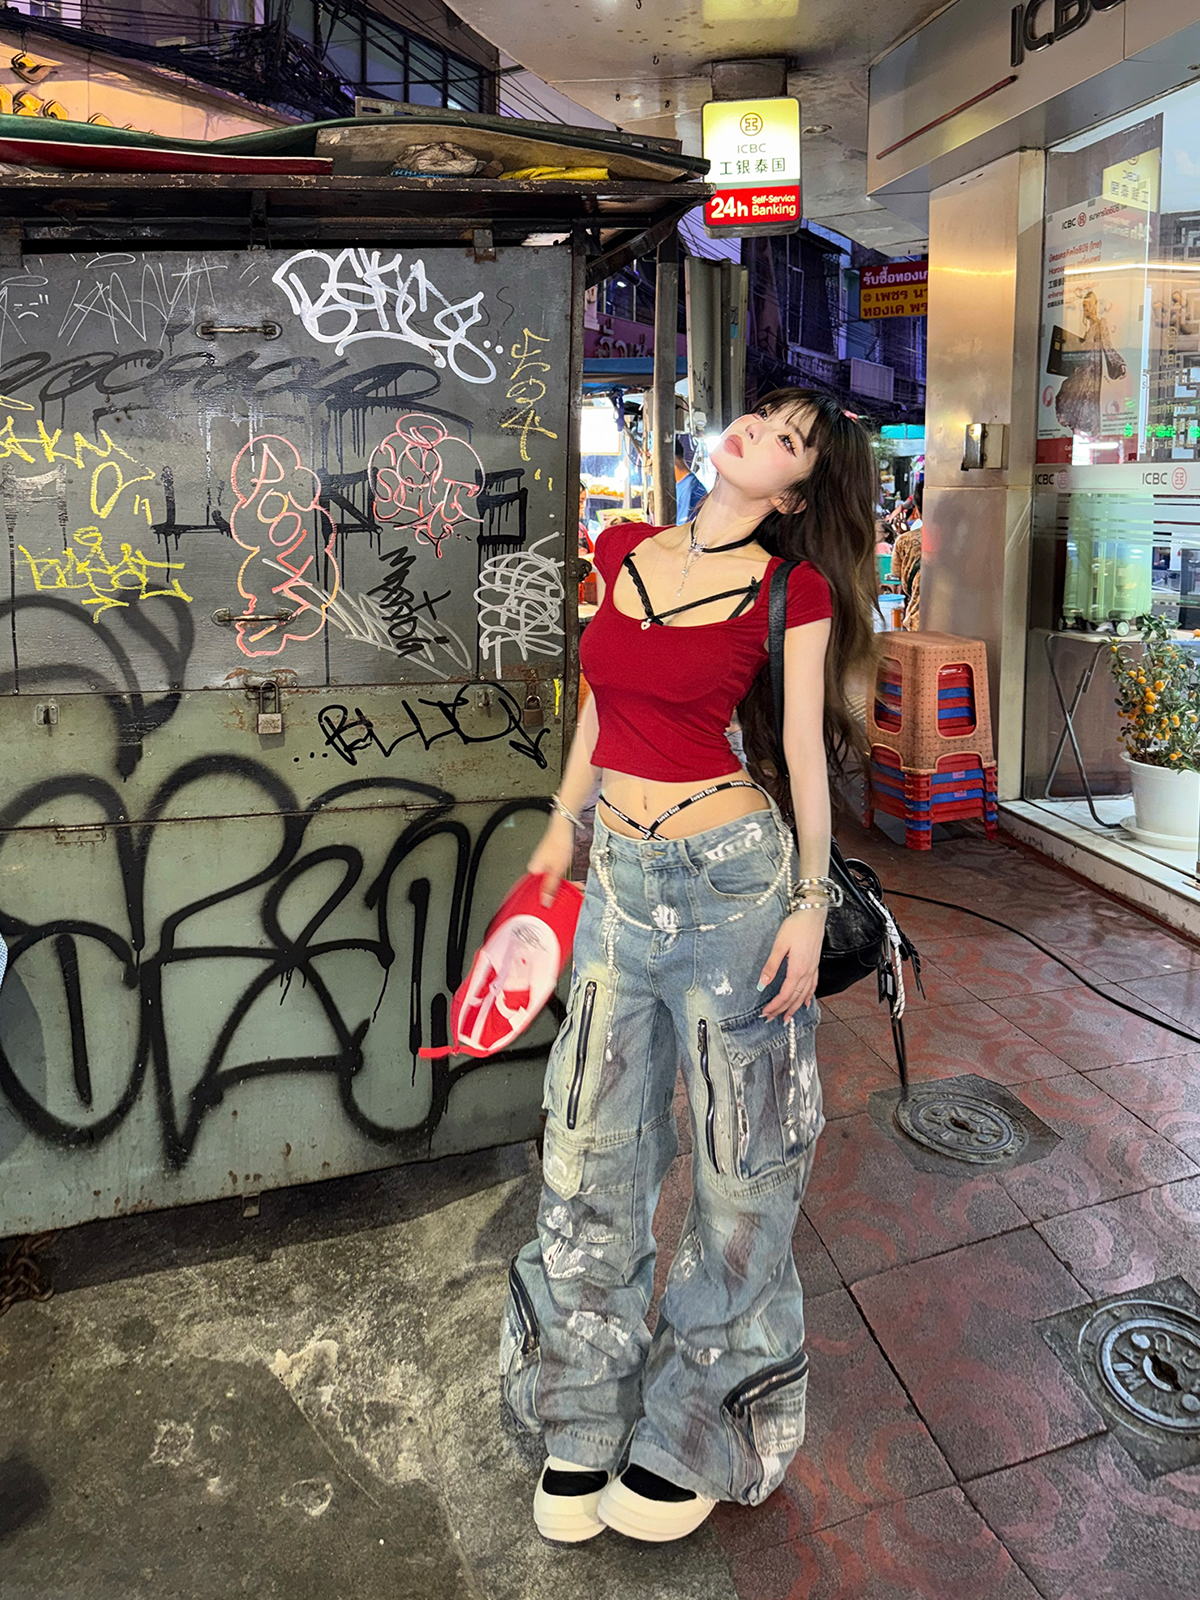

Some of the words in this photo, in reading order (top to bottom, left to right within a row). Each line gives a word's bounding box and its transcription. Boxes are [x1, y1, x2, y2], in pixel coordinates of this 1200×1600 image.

[1010, 0, 1125, 67] ICB
[737, 143, 766, 154] ICBC
[719, 157, 786, 175] 工银泰国
[751, 194, 797, 205] Self-Service
[711, 196, 749, 219] 24h
[751, 202, 797, 217] Banking
[1061, 217, 1077, 231] ICBC
[875, 290, 908, 302] เพชร
[863, 304, 905, 317] ทองเค
[1035, 473, 1055, 486] ICBC
[1142, 472, 1168, 485] ICBC
